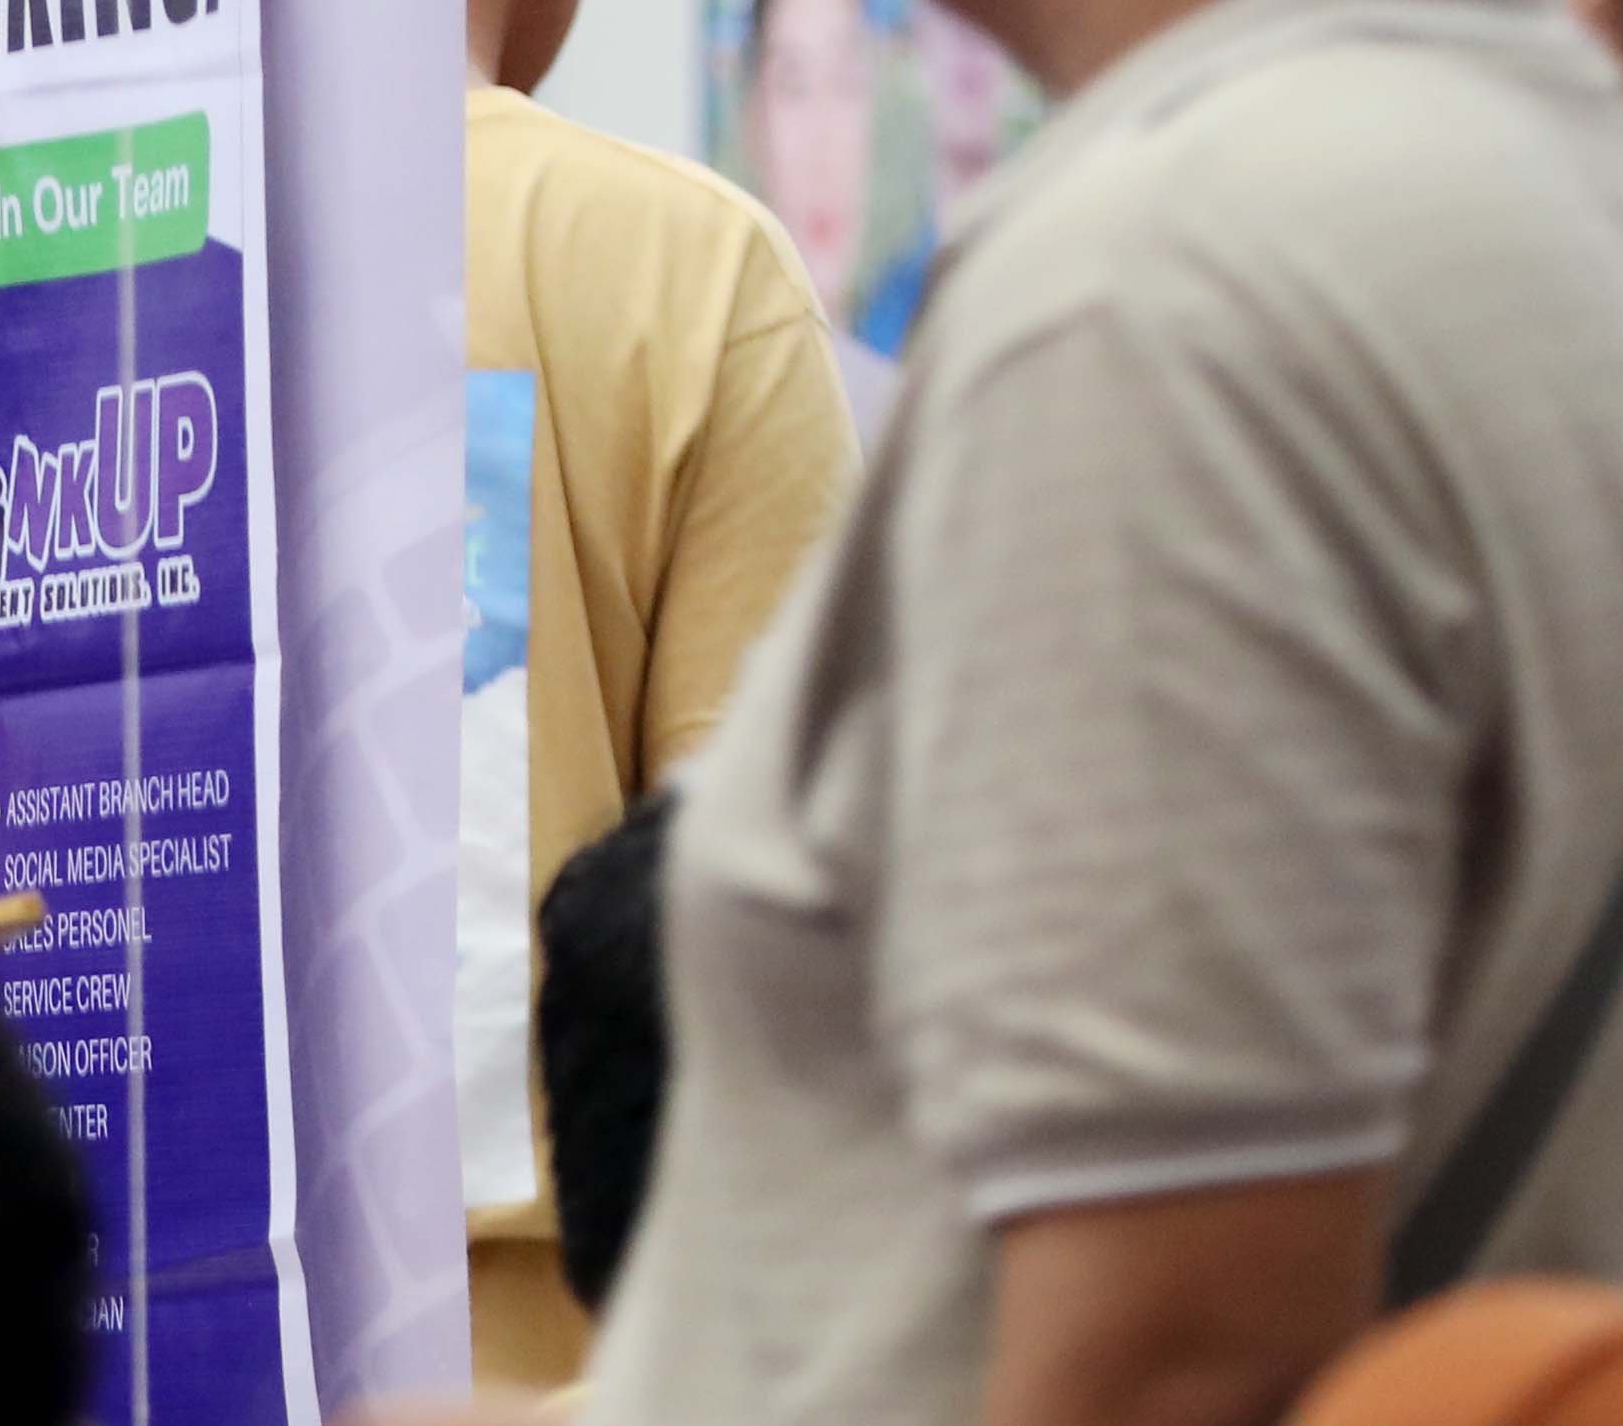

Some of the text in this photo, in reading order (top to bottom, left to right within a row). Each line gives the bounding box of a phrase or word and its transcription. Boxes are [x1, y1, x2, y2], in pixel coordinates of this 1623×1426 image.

[33, 175, 103, 235] Our
[111, 163, 189, 221] Team
[158, 556, 200, 606] INC.
[6, 769, 230, 827] ASSISTANT BRANCH HEAD
[4, 833, 232, 890] SOCIAL MEDIA SPECIALIST
[57, 906, 152, 950] PERSONEL
[4, 973, 131, 1016] SERVICE CREW
[74, 1035, 153, 1076] OFFICER
